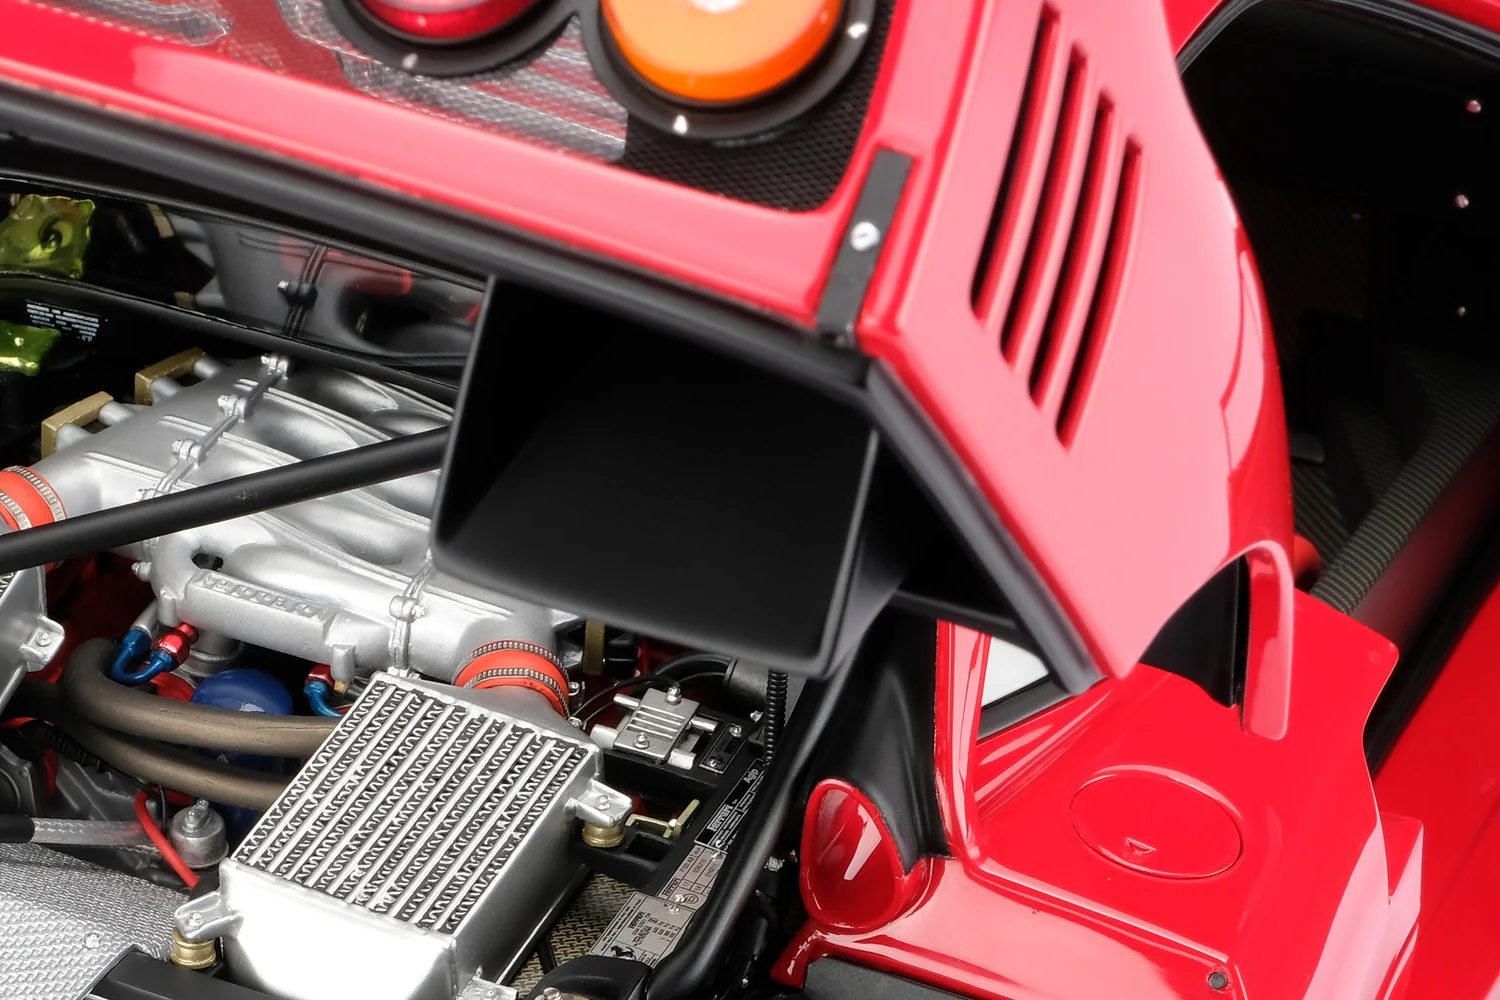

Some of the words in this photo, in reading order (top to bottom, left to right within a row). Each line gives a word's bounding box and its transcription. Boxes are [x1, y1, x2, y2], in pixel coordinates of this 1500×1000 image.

[743, 768, 759, 784] Agip
[706, 803, 734, 832] Ferrari
[662, 877, 681, 896] Ferrari
